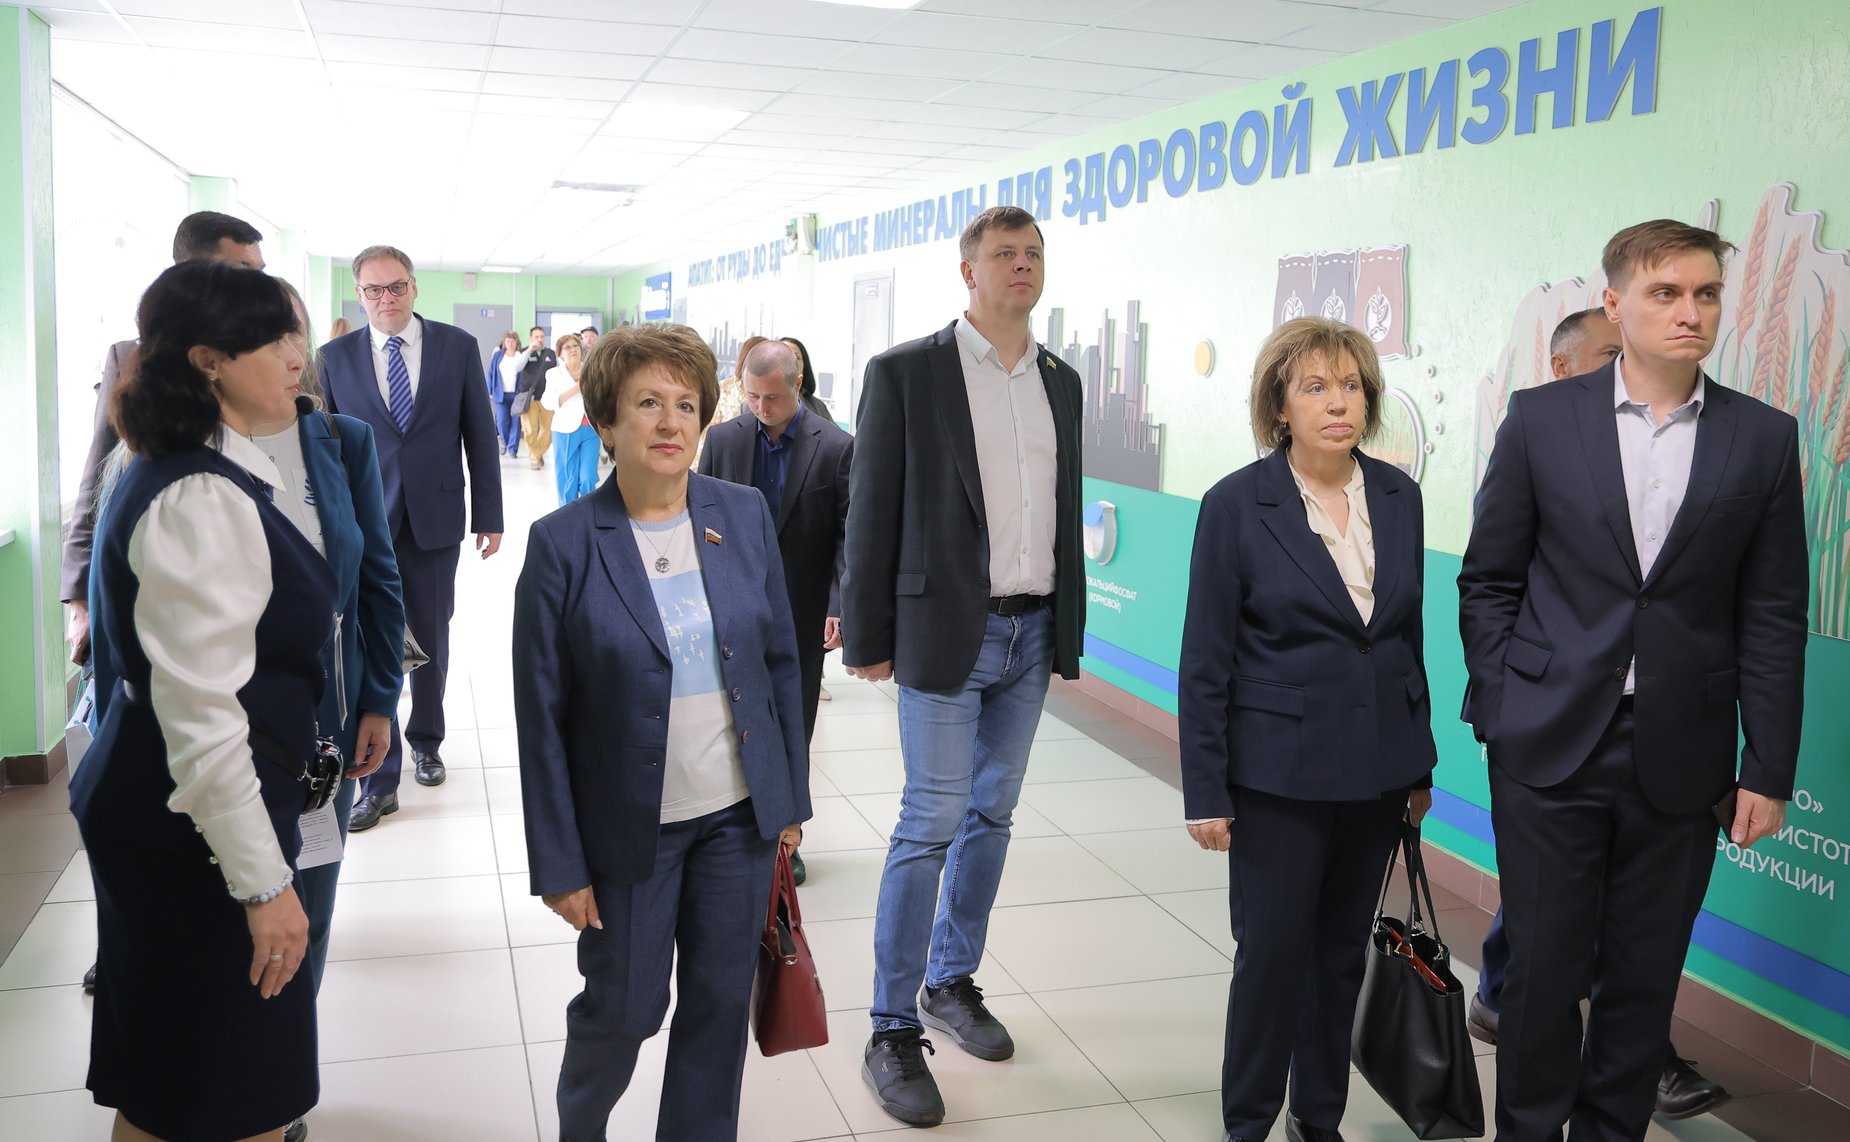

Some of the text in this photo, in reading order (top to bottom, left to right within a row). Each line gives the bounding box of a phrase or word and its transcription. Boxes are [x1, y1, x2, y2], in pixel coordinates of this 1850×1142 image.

[873, 184, 986, 252] МИНЕРАЛЫ
[1061, 82, 1314, 225] ЗДОРОВОЙ
[1333, 6, 1664, 168] ЖИЗНИ
[688, 259, 715, 287] АПАТИТ:
[716, 254, 726, 282] ОТ
[728, 248, 751, 284] РУДЫ
[752, 242, 767, 281] ДО
[1772, 825, 1850, 865] ИСТОТ
